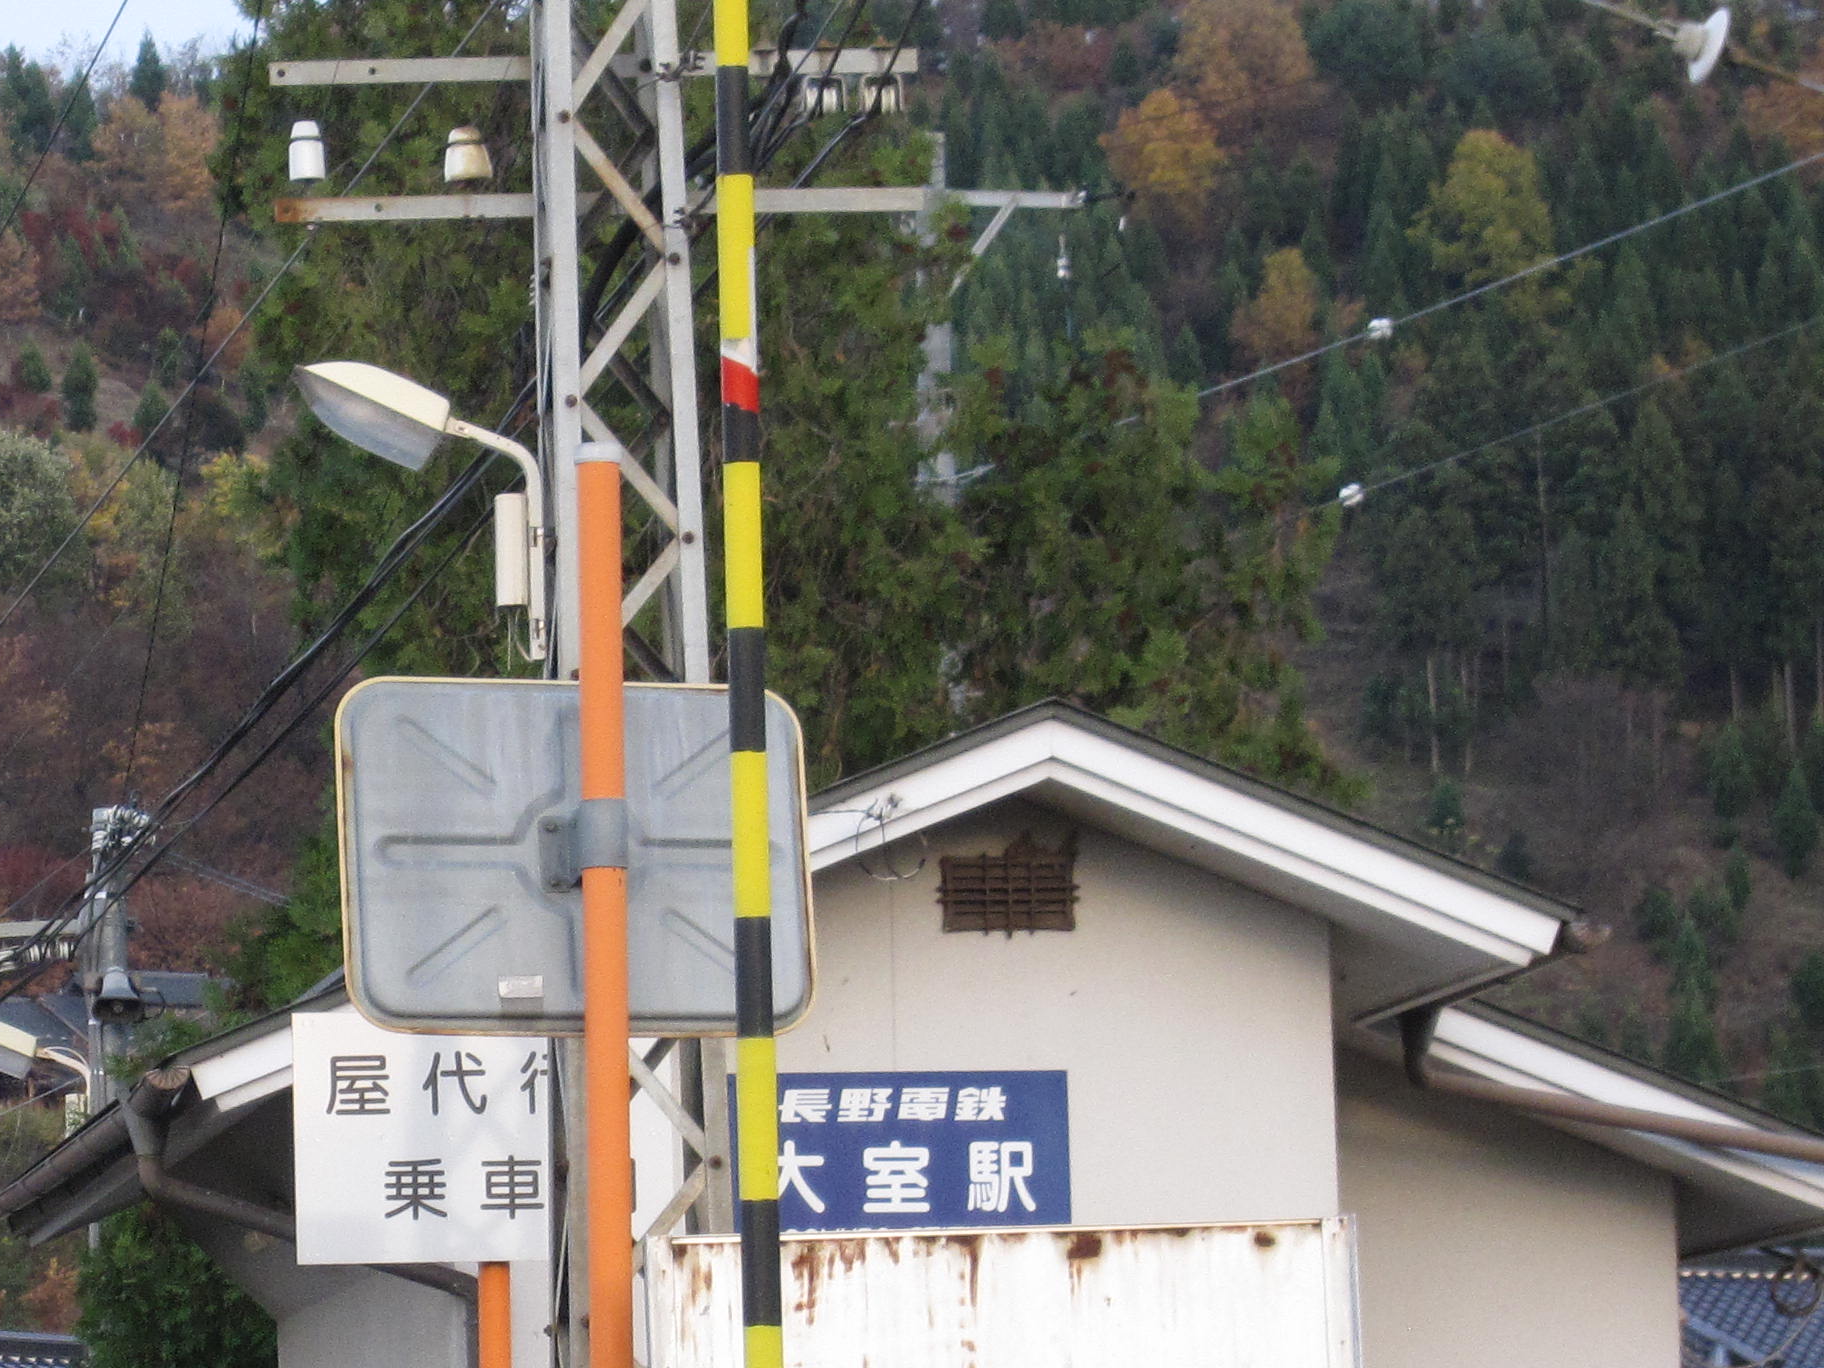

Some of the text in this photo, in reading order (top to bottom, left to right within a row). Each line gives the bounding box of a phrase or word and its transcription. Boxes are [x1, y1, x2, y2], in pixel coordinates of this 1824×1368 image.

[778, 1086, 1008, 1123] 長野電鉄
[384, 1154, 637, 1221] 乗車
[777, 1139, 1037, 1214] 大室駅
